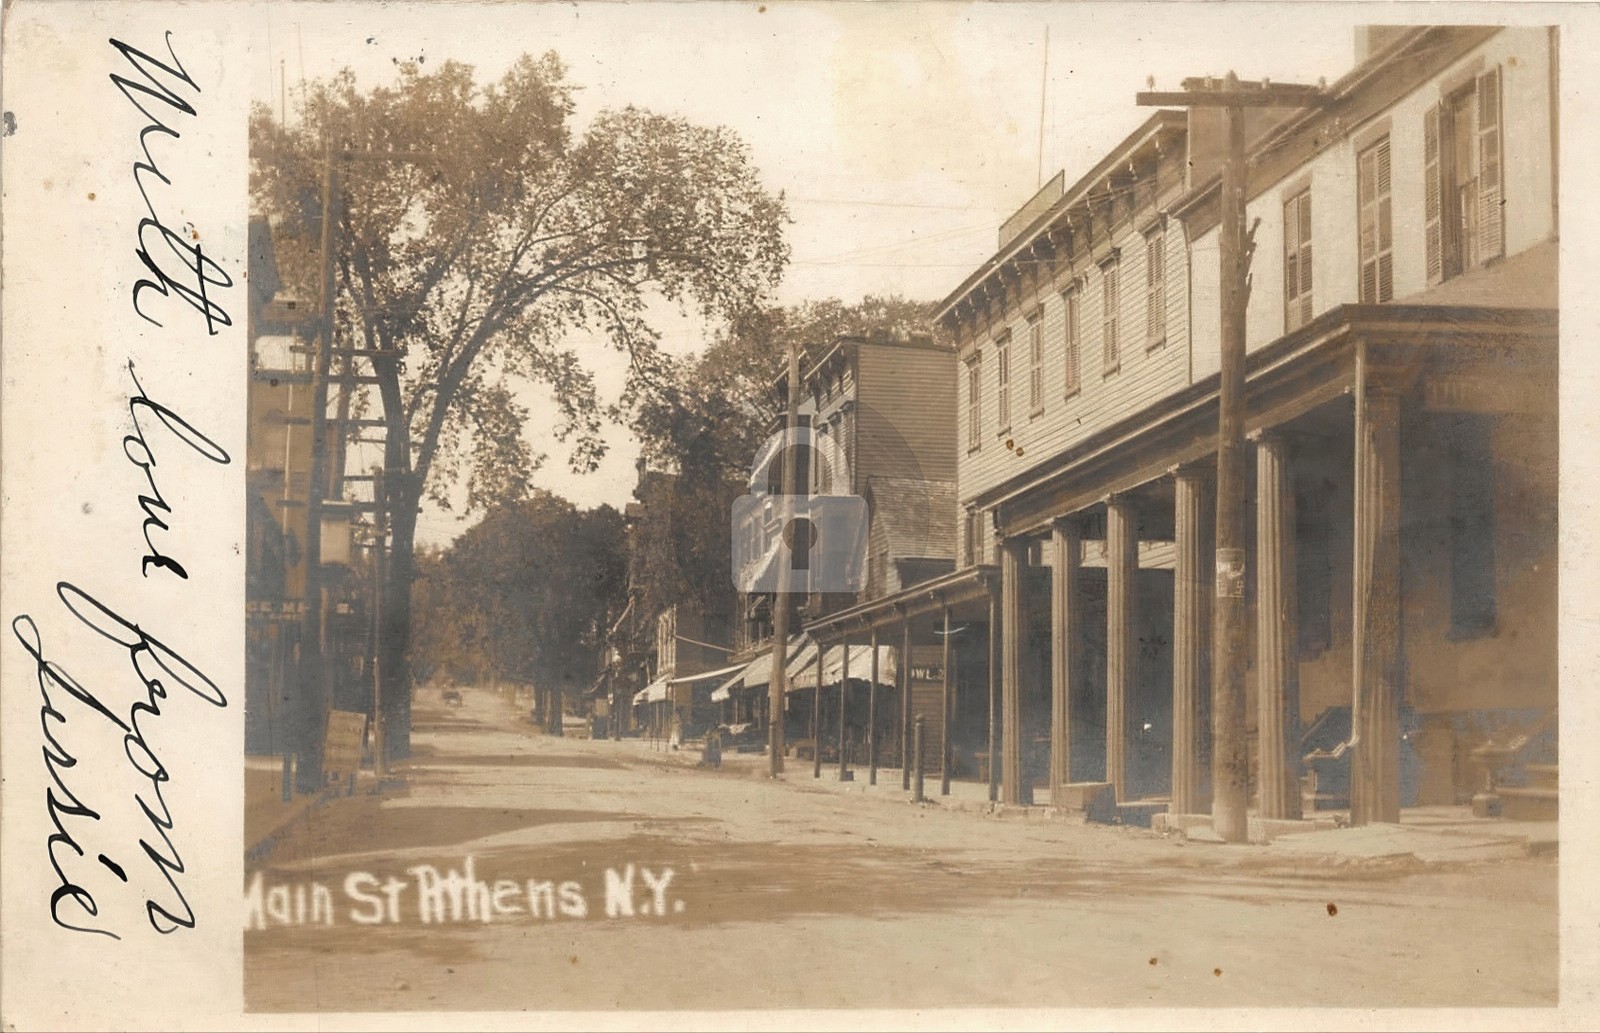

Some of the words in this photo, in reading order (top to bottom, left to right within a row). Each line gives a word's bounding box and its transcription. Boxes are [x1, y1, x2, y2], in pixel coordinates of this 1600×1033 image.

[108, 31, 233, 336] With
[124, 358, 231, 580] love
[13, 614, 131, 940] Jessie
[57, 581, 228, 934] from
